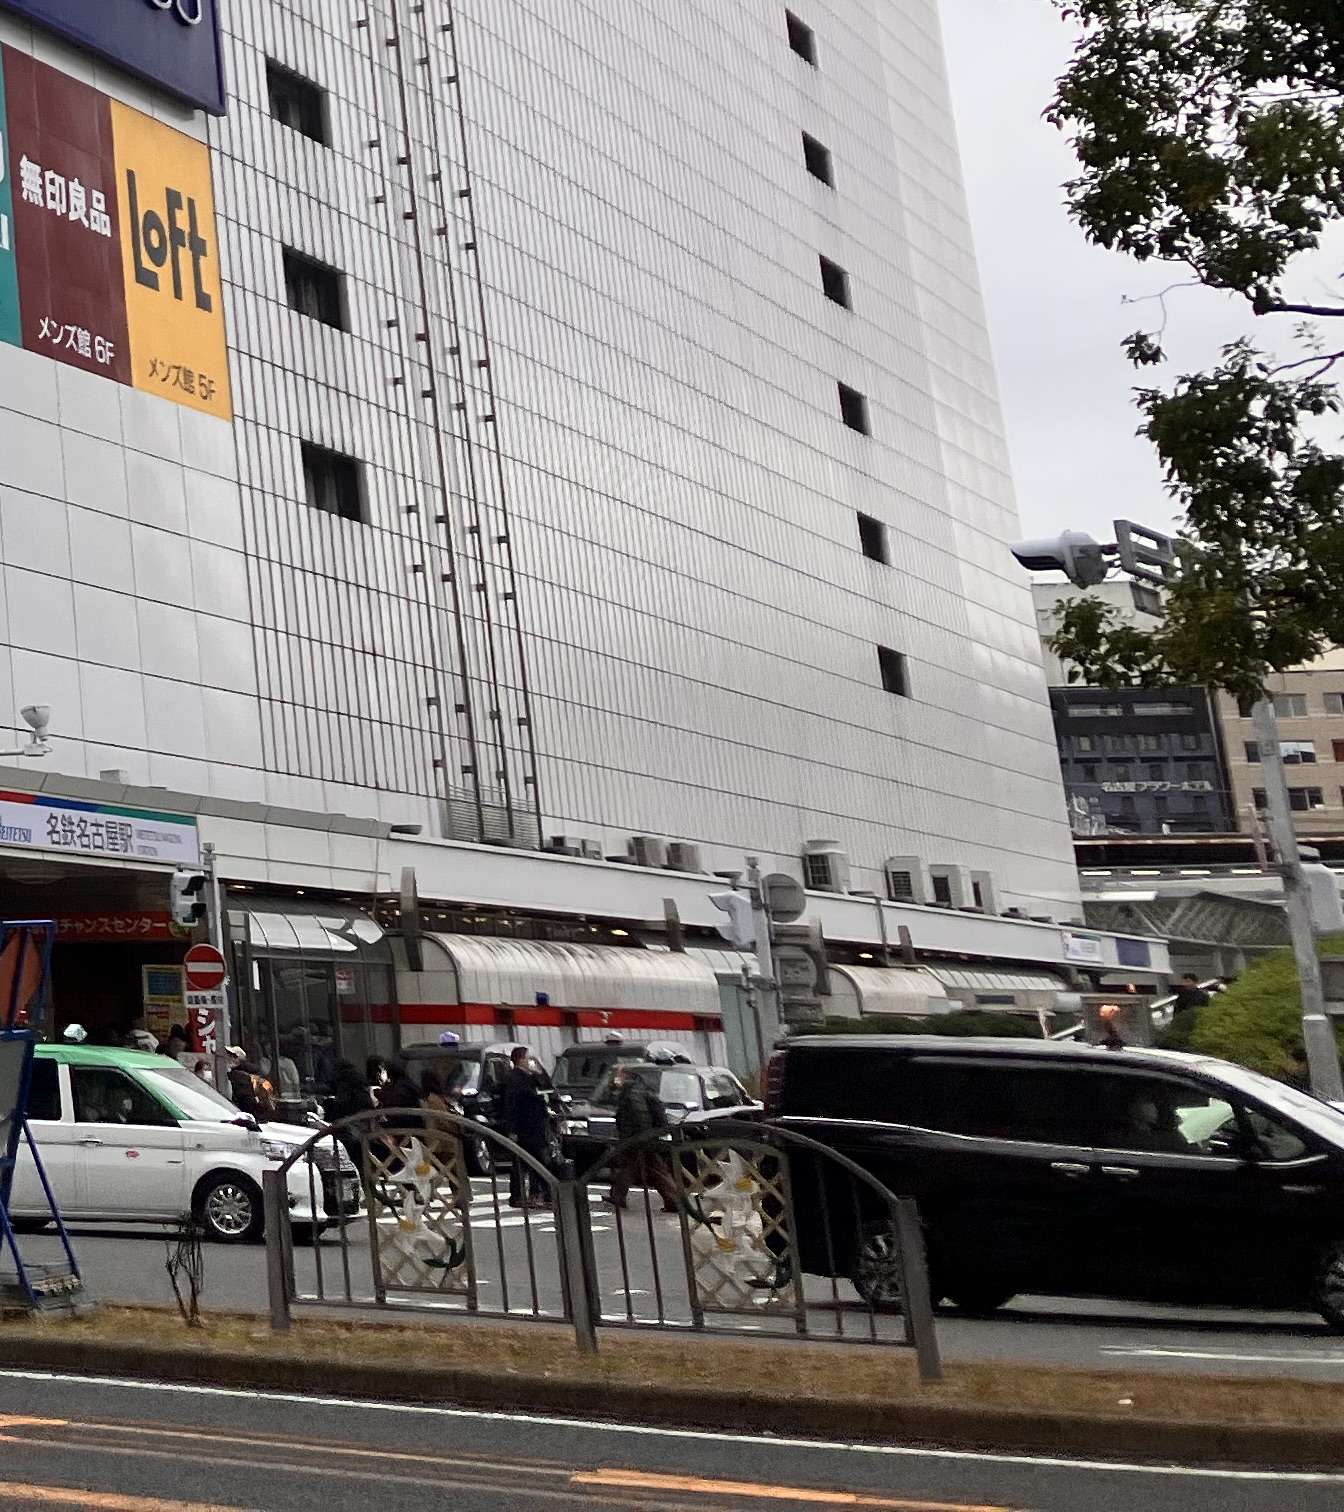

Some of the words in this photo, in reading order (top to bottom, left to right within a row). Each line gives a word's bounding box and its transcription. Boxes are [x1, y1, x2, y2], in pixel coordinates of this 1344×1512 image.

[19, 153, 112, 238] 無印良品
[37, 314, 92, 360] メンズ館
[94, 324, 116, 365] 6F
[148, 356, 194, 398] メンズ館
[196, 369, 217, 401] 5F
[46, 812, 133, 853] 名鉄名古屋駅
